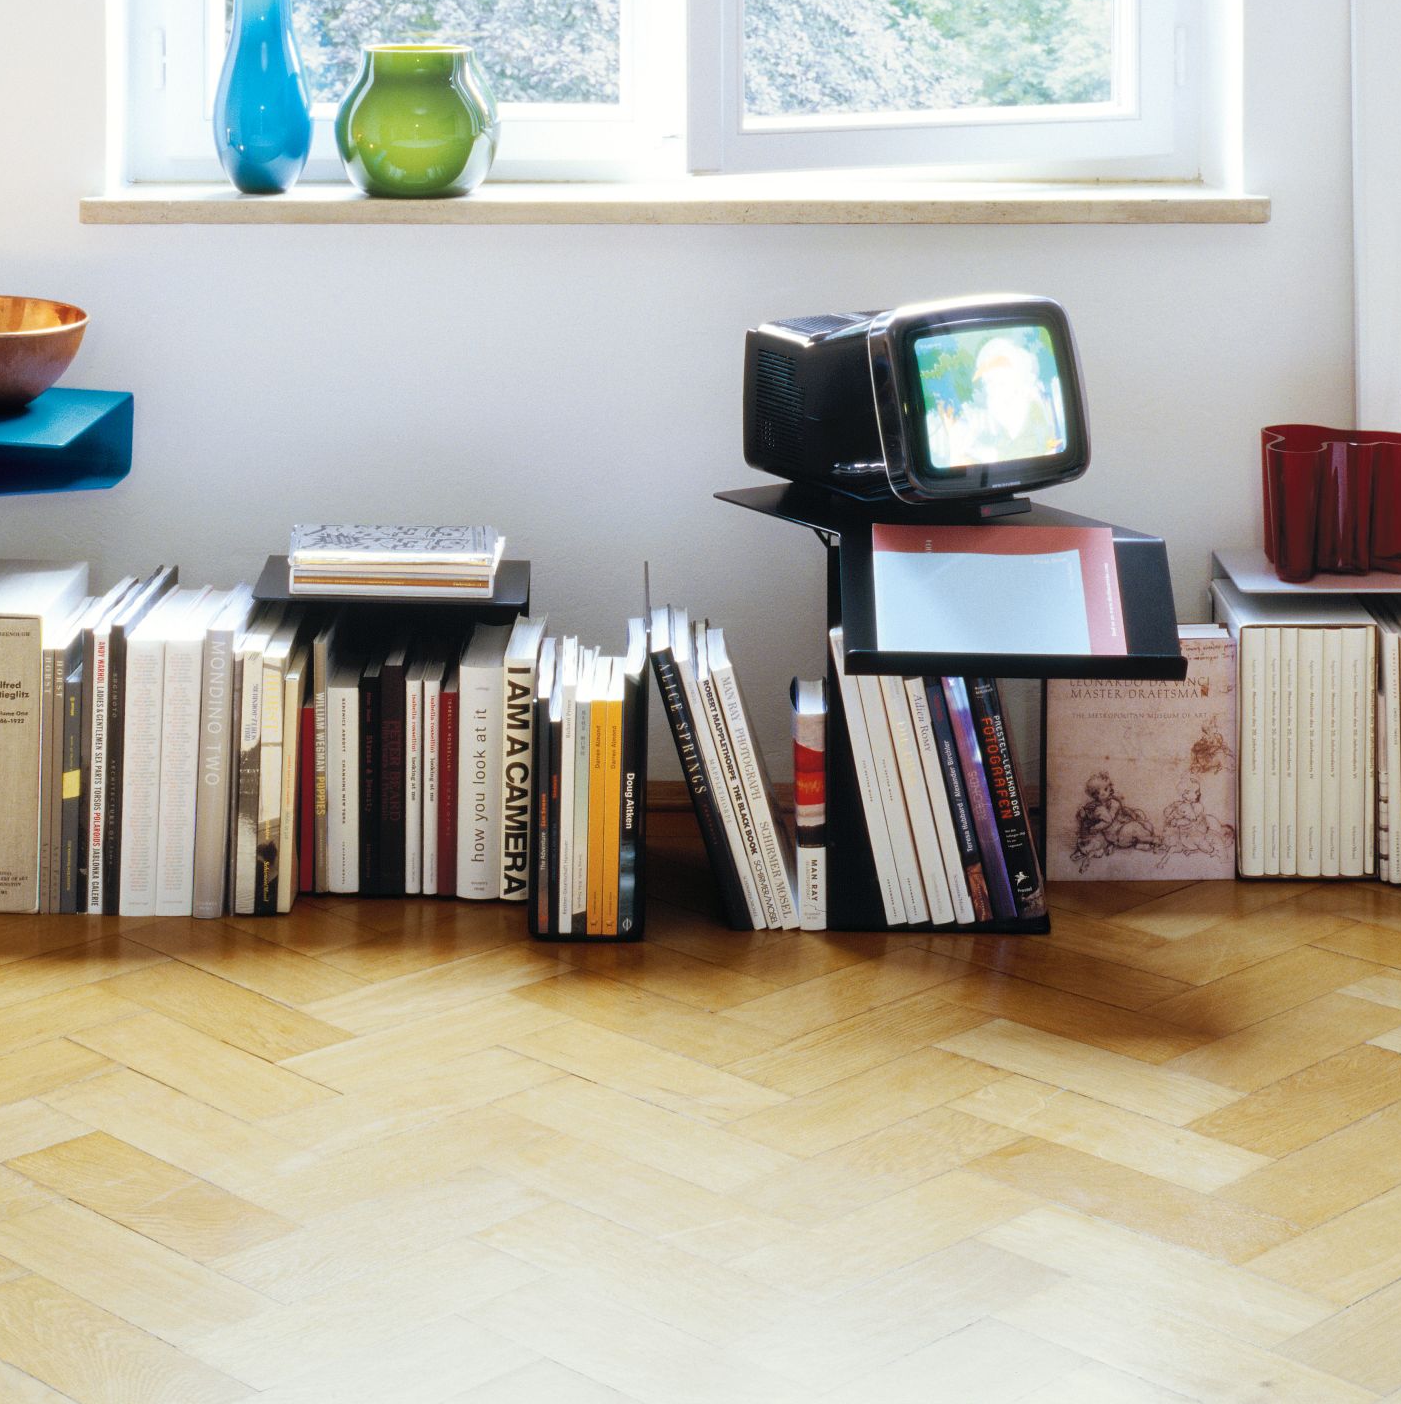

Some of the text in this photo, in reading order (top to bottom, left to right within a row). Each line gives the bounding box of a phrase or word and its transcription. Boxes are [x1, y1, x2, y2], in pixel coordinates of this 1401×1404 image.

[97, 641, 105, 658] ANDY
[721, 676, 733, 700] MAN
[1070, 679, 1143, 687] LEONARDO
[1173, 677, 1210, 687] VINCI
[1071, 689, 1208, 699] MASTER DRAFTSMAN
[96, 686, 104, 707] LADIES
[702, 680, 716, 712] ROBERT
[205, 641, 225, 786] MONDINO TWO
[726, 701, 742, 721] RAY
[95, 714, 103, 750] GENTLEMEN
[658, 663, 706, 794] ALICE SPRINGS
[95, 752, 103, 764] SEX
[315, 692, 325, 815] WILLIAM WEGMAN PUPPIES
[710, 714, 737, 781] MAPPLETHORPE
[94, 766, 102, 784] PARTS
[981, 717, 1013, 820] FOTOGRAFEN
[993, 715, 1020, 817] PRESTEL-LEXIKON DER
[411, 782, 416, 790] at
[471, 709, 487, 862] how you look at it
[503, 667, 531, 896] I AM A CAMERA
[731, 785, 740, 801] THE
[93, 787, 102, 811] TORSOS
[411, 791, 416, 801] me
[624, 773, 635, 829] Doug Aitken
[735, 802, 750, 828] BLACK
[93, 812, 101, 847] POLAROIDS
[742, 830, 758, 855] BOOK
[92, 848, 100, 879] JABLONKA
[759, 821, 792, 918] SCHIRMER/MOSEL
[91, 881, 99, 906] GALERIE
